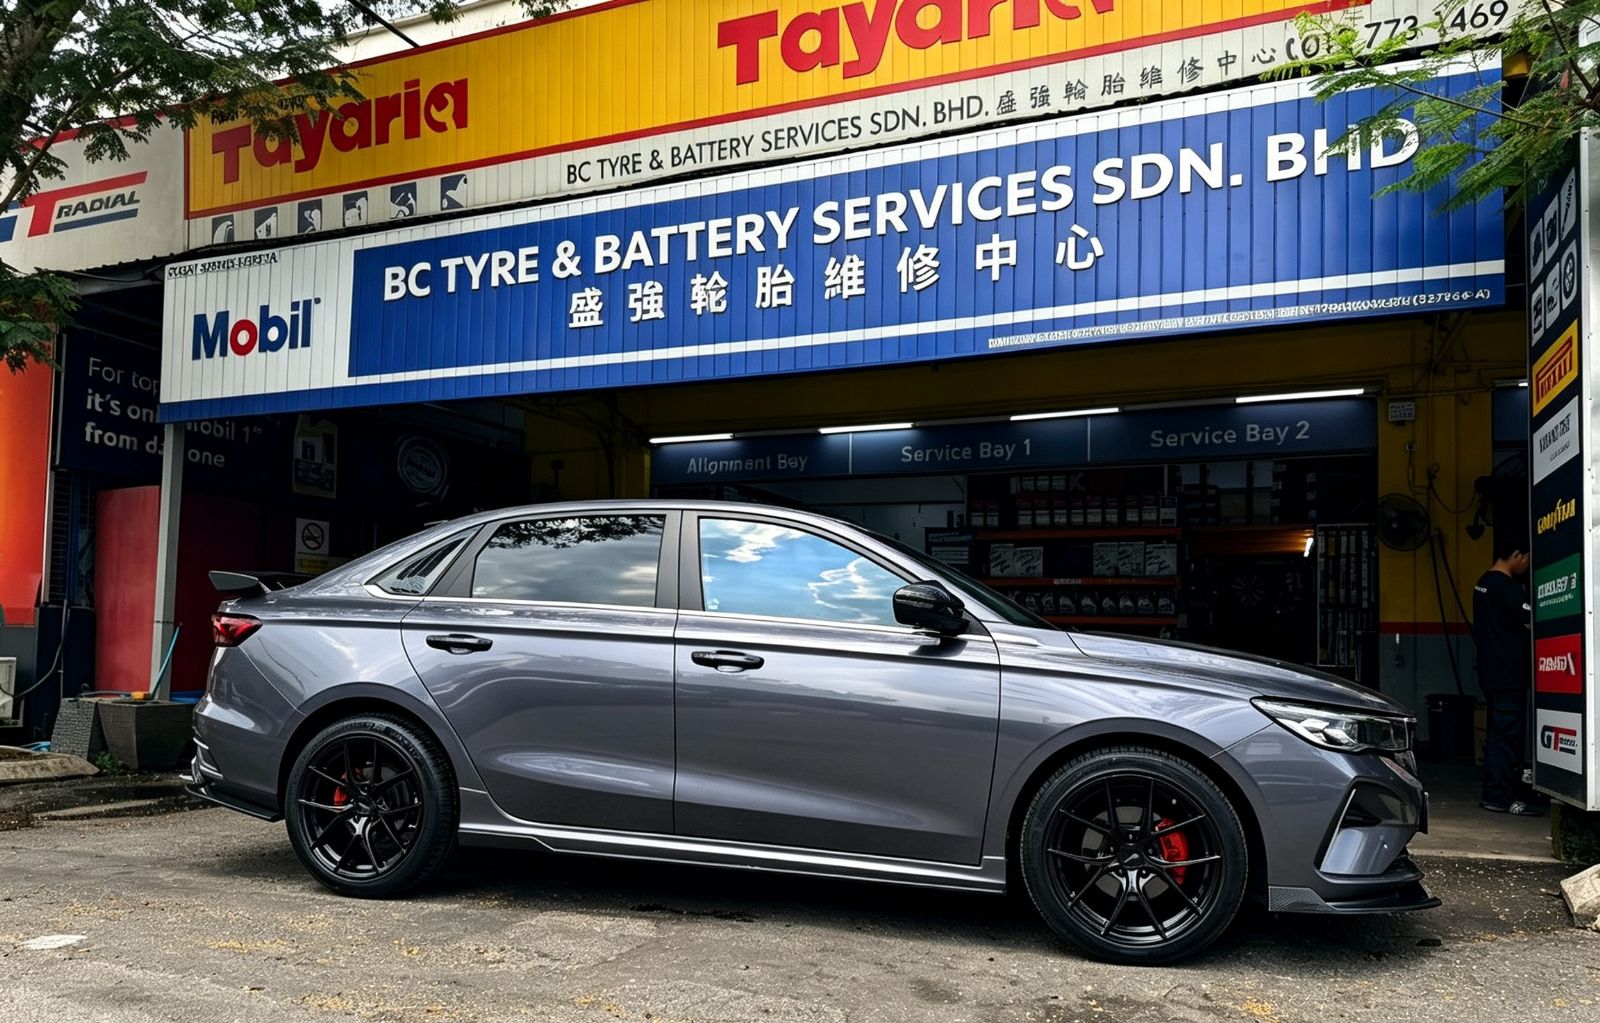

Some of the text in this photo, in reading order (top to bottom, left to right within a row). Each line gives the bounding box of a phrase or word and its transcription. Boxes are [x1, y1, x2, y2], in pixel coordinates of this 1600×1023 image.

[717, 0, 1114, 85] Tayar
[212, 78, 468, 185] Tayaria
[566, 95, 990, 184] BC TYRE & BATTERY SERVICES SDN. BHD.
[56, 190, 142, 220] RADIAL
[384, 118, 1420, 302] BC TYRE & BATTERY SERVICES SDN. BHD
[192, 298, 313, 361] Mobil
[88, 356, 124, 384] For
[85, 387, 121, 416] it's
[84, 422, 139, 453] from
[187, 448, 225, 468] one
[901, 439, 1031, 462] Service Bay 1
[1150, 421, 1310, 449] Service Bay 2
